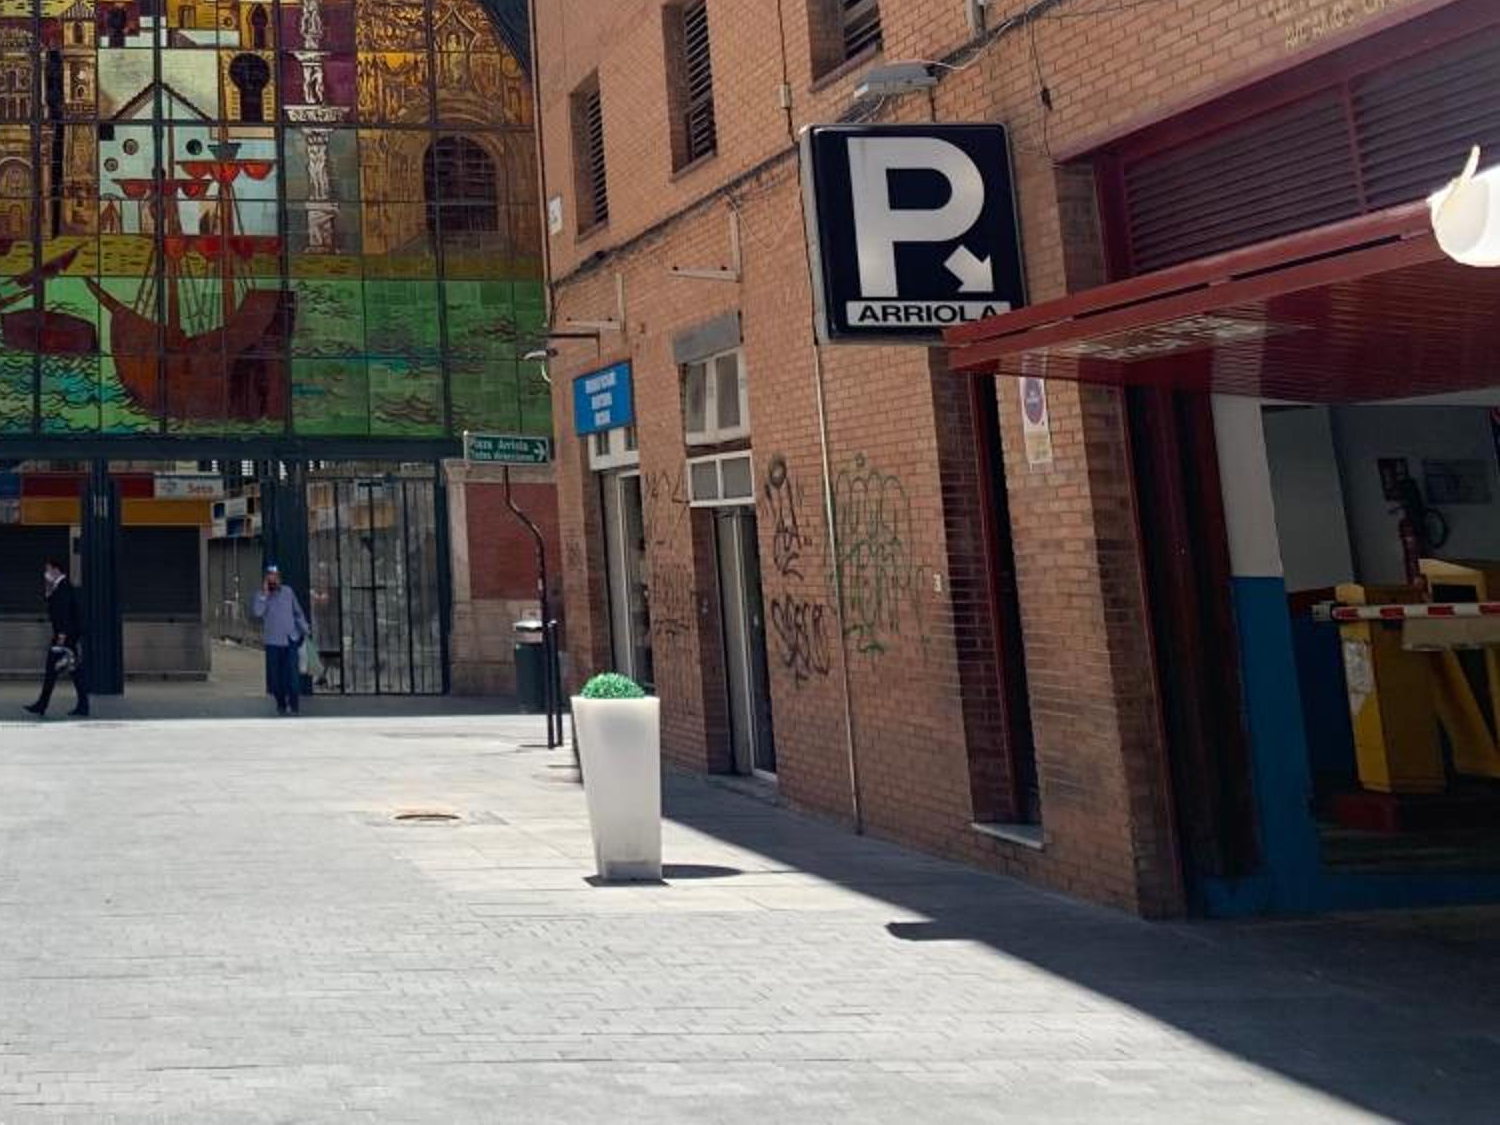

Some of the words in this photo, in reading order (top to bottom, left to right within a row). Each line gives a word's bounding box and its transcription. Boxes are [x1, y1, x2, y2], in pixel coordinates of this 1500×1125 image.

[847, 136, 985, 298] P
[858, 305, 997, 322] ARRIOLA
[499, 438, 529, 451] Arriola
